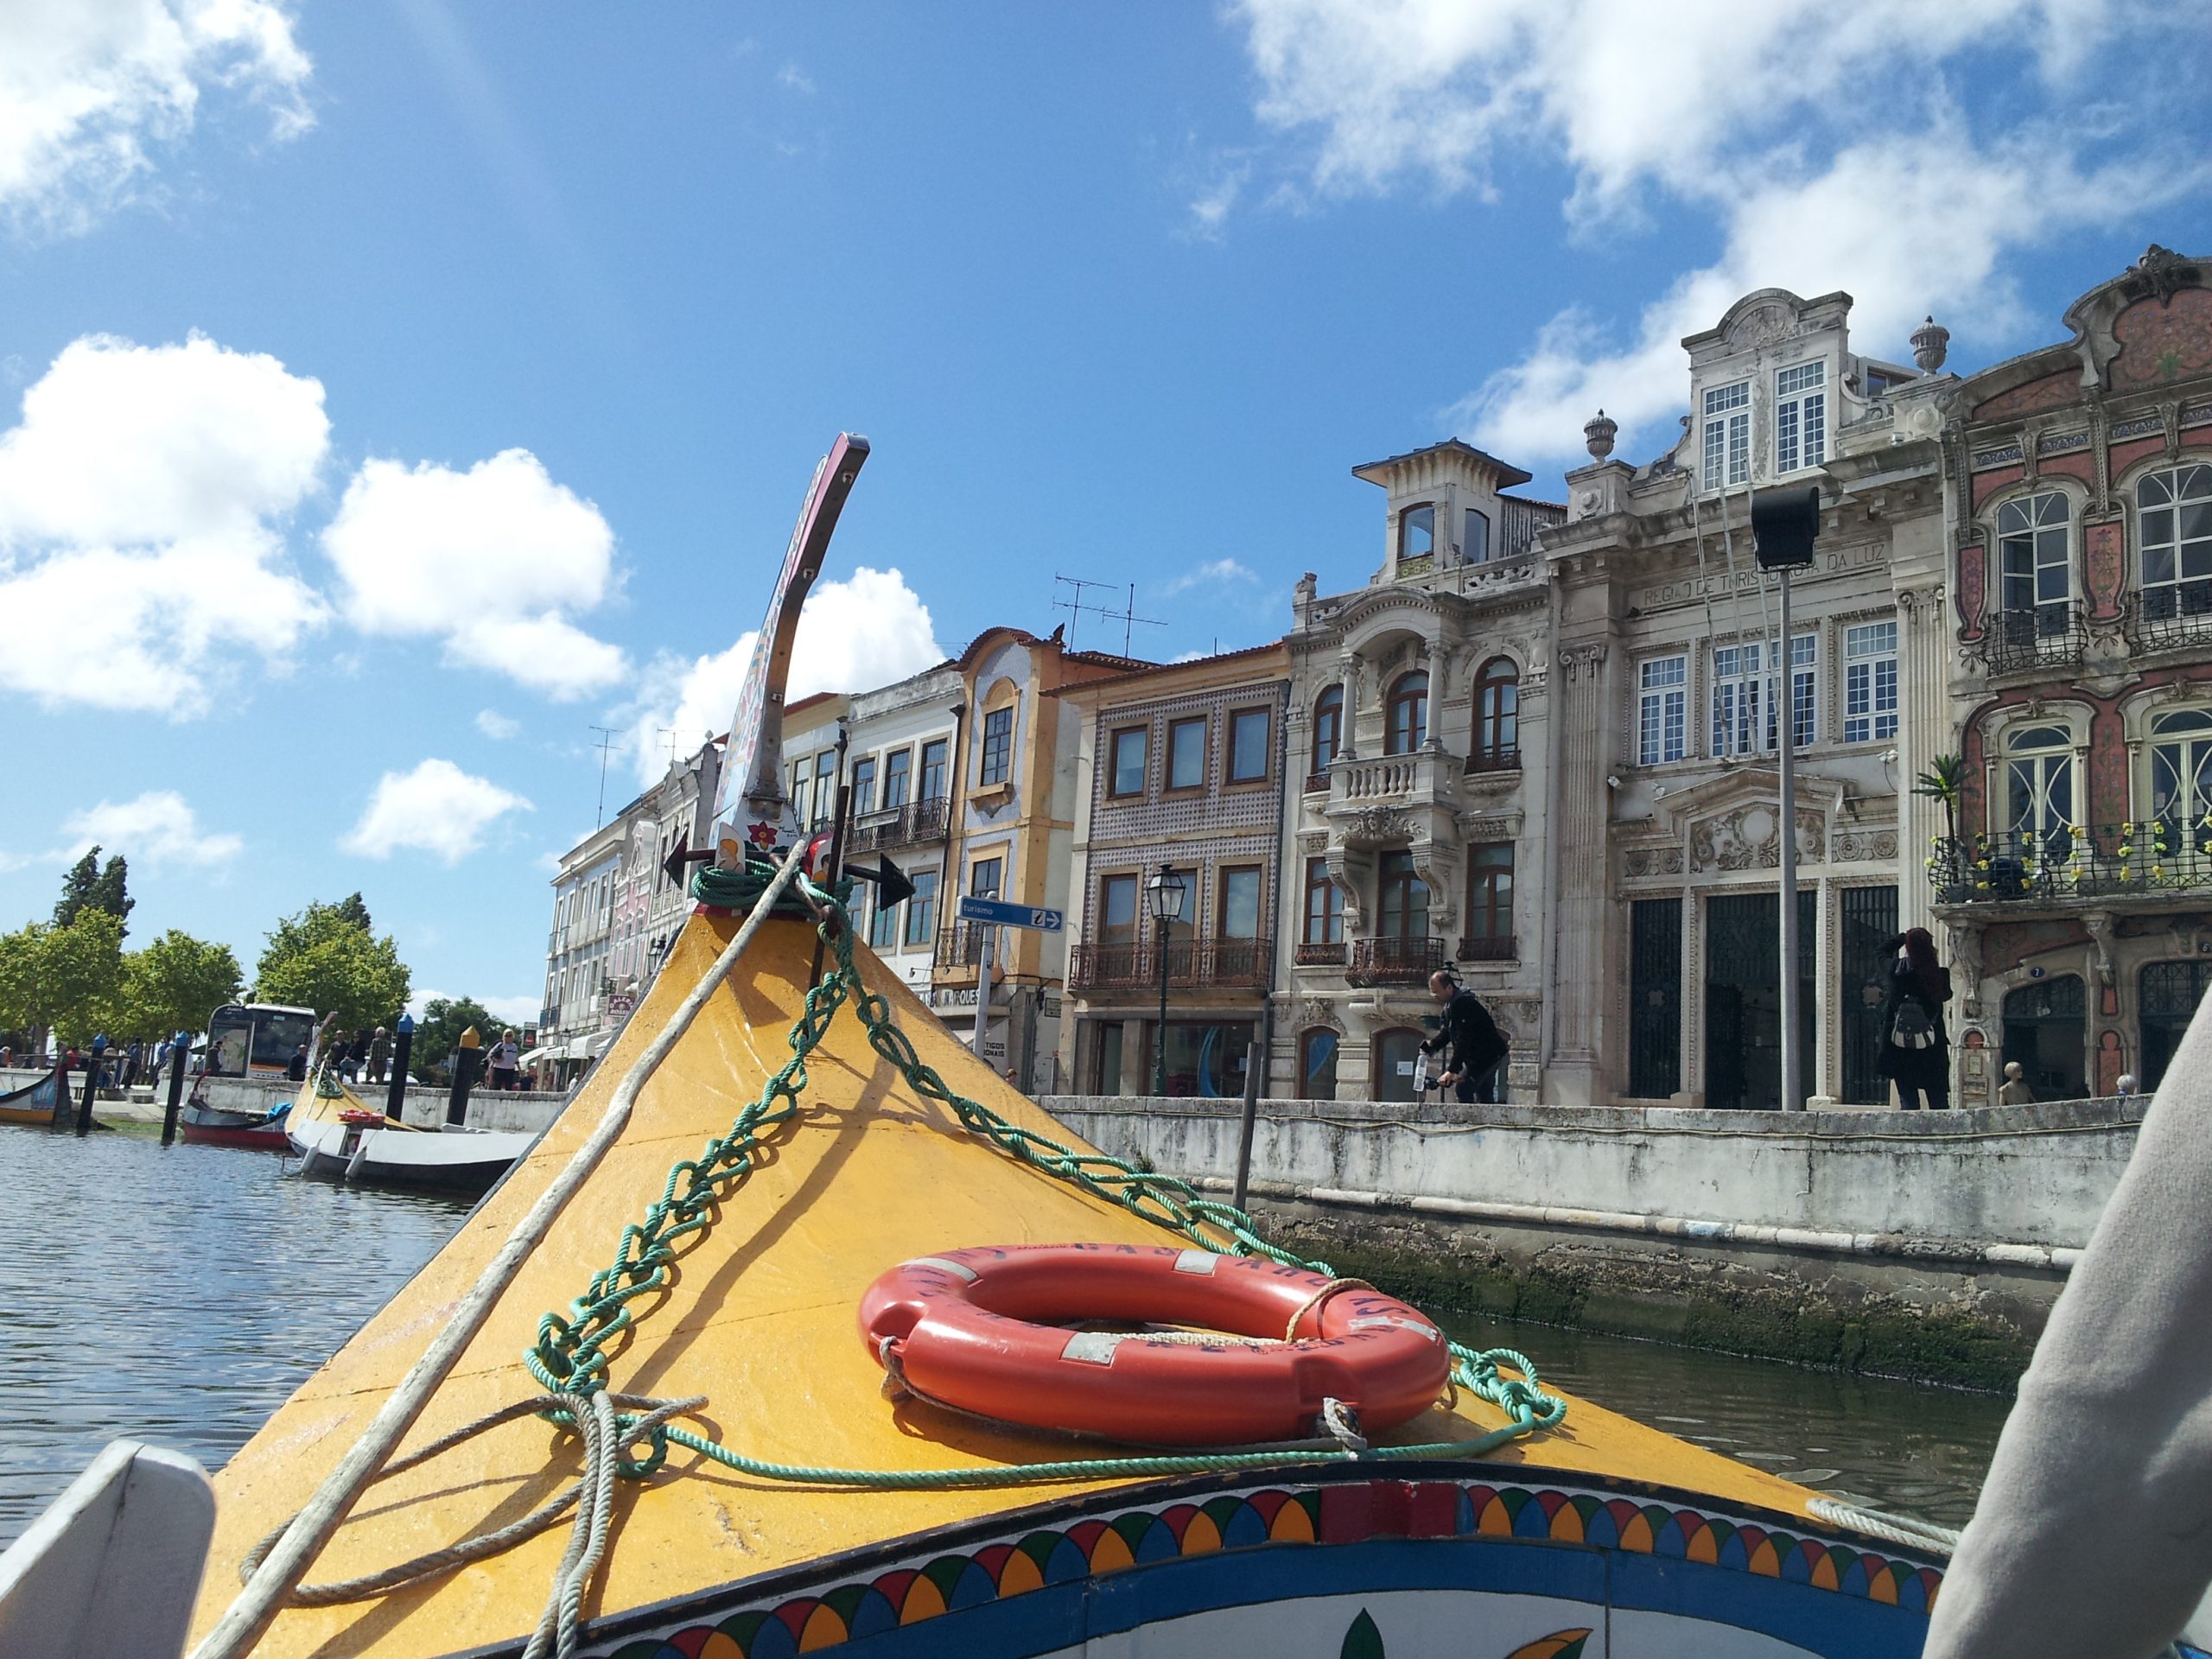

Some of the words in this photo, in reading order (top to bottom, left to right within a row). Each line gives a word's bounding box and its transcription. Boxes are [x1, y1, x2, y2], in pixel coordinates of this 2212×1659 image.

[1696, 576, 1715, 596] DE
[1827, 553, 1847, 570] DA
[1853, 543, 1885, 566] LUZ
[963, 904, 994, 915] turismo
